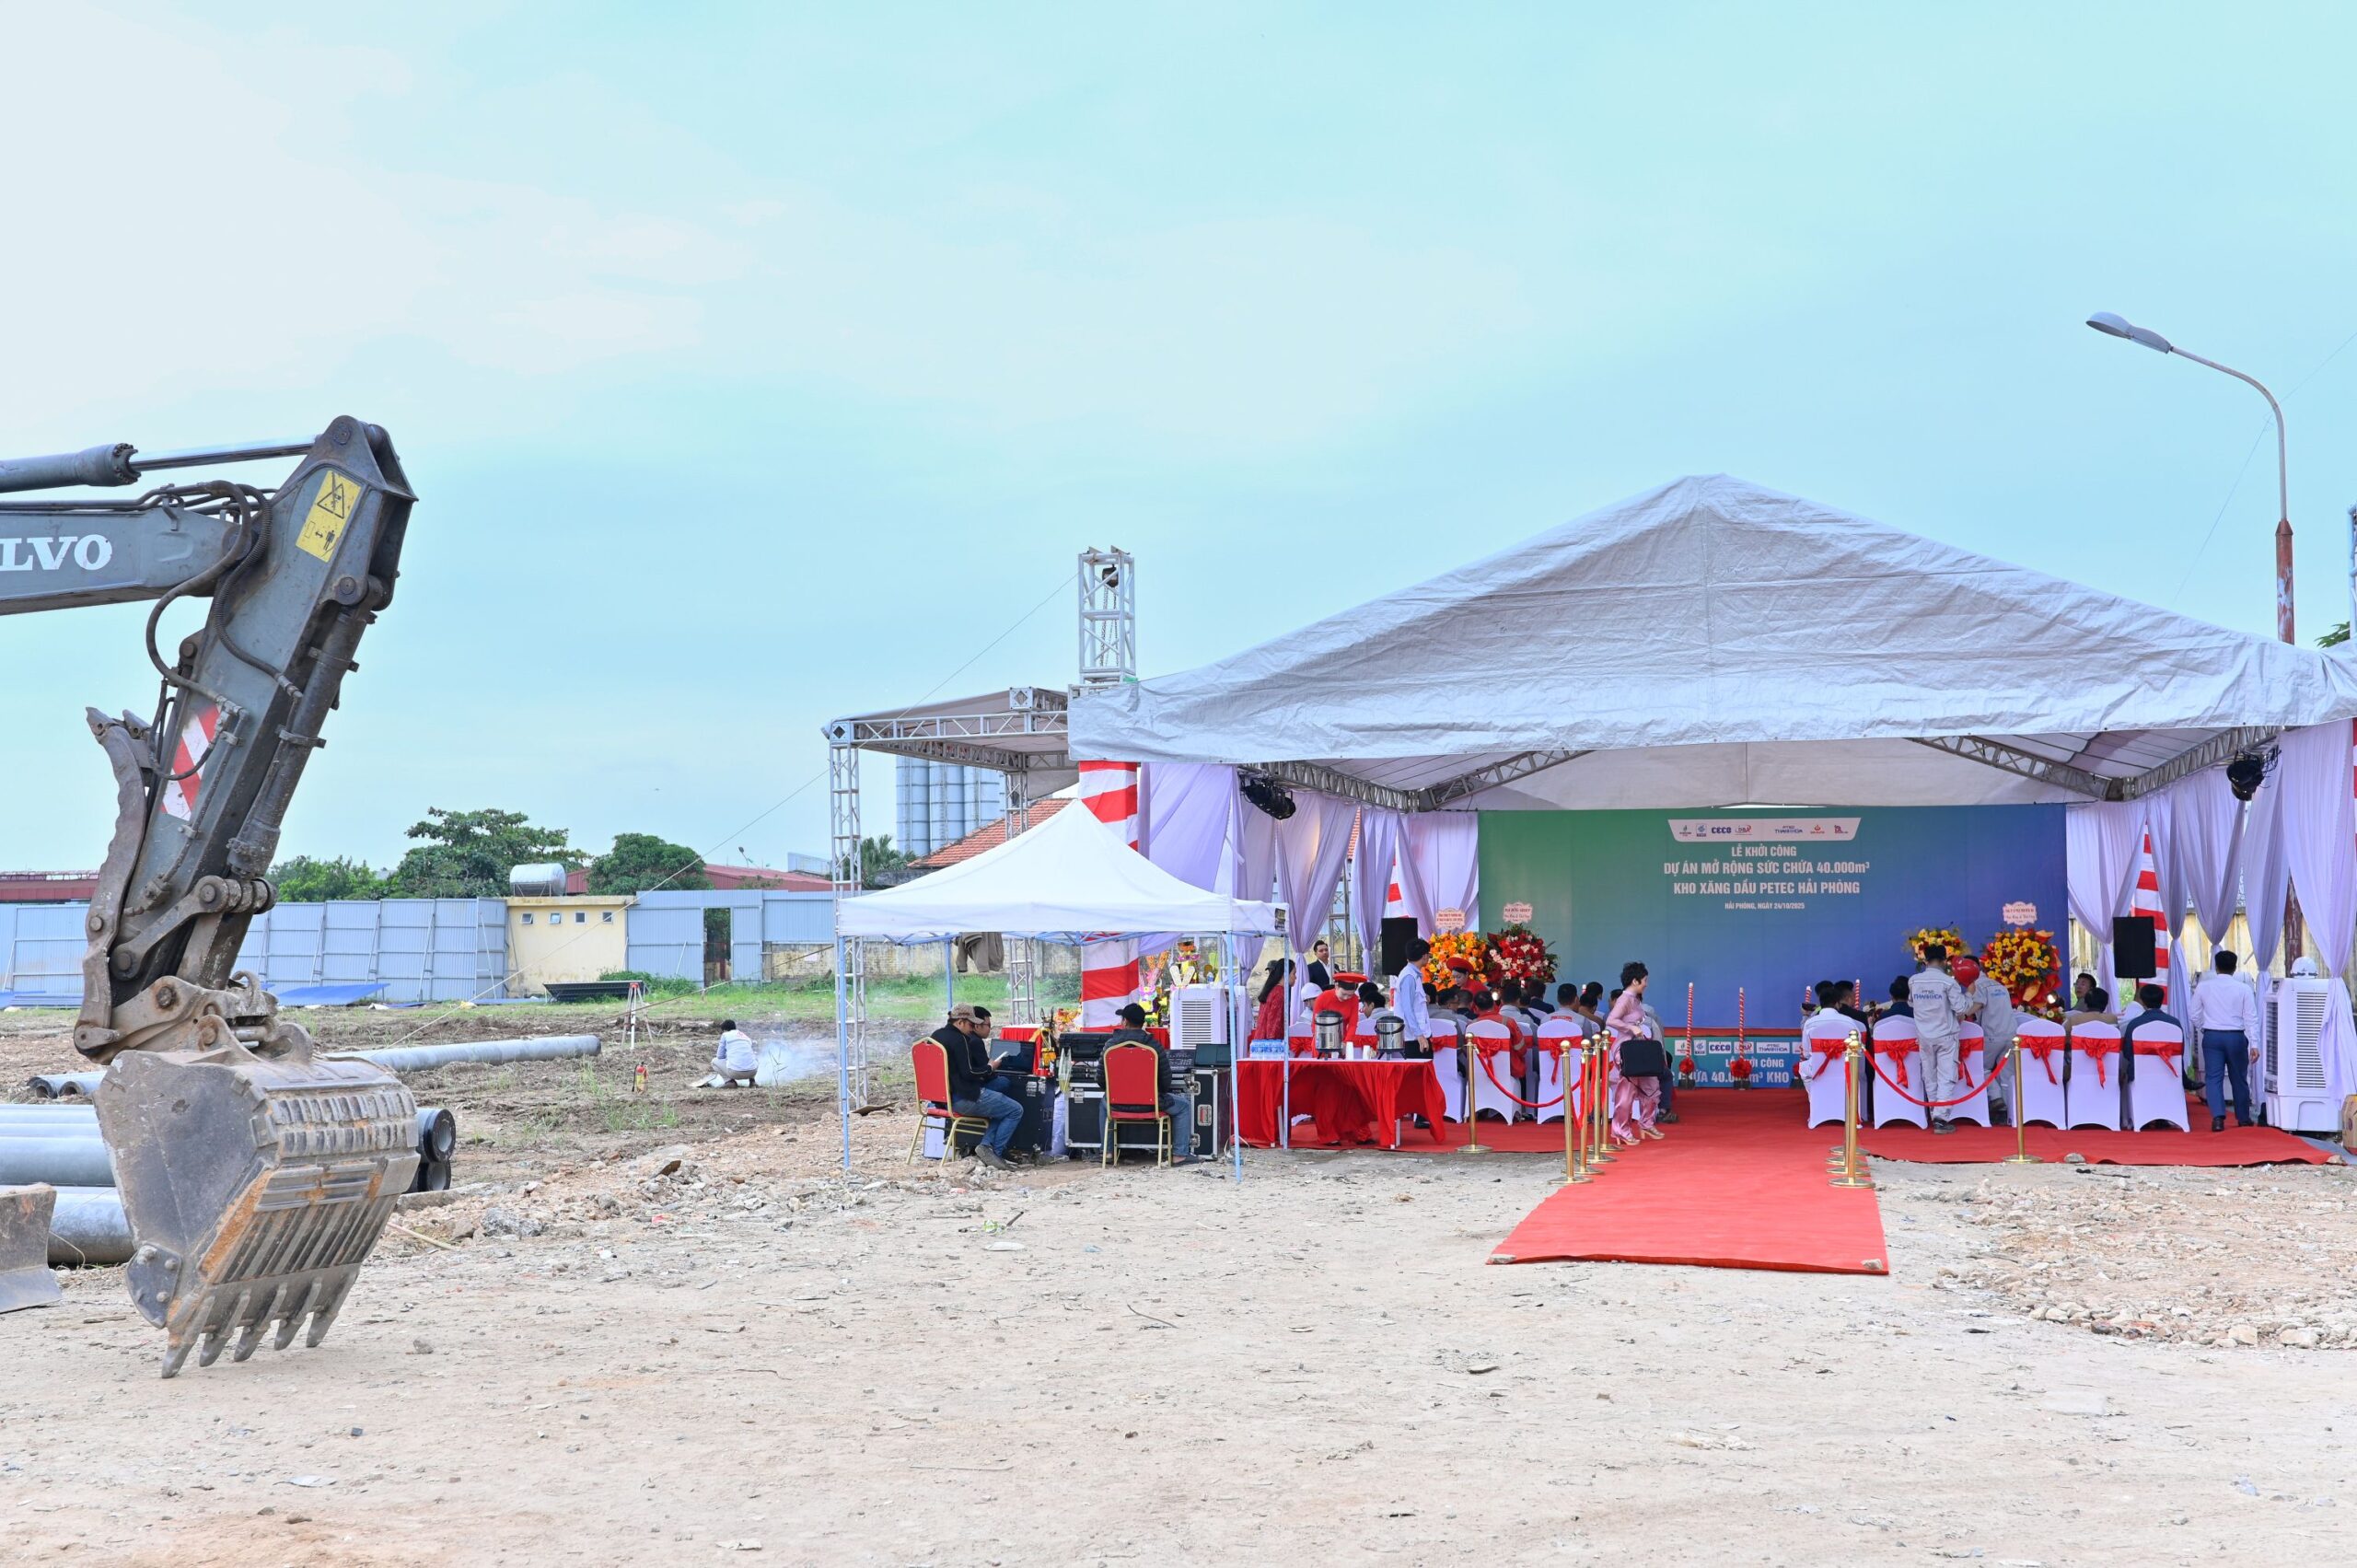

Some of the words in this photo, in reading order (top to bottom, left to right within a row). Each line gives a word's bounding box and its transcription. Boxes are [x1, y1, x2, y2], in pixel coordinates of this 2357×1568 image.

[0, 534, 112, 571] LVO
[1732, 843, 1743, 857] LỄ
[1745, 843, 1768, 857] KHỞI
[1770, 844, 1797, 857] CÔNG
[1664, 861, 1680, 877] DỰ
[1682, 860, 1699, 874] ÁN
[1701, 858, 1720, 874] MỞ
[1723, 860, 1754, 877] RỘNG
[1757, 860, 1780, 874] SỨC
[1782, 859, 1814, 874] CHỨA
[1674, 882, 1696, 894] KHO
[1700, 880, 1731, 894] XĂNG
[1759, 882, 1794, 894] PETEC
[1798, 877, 1817, 894] HẢI
[1820, 879, 1860, 894] PHÒNG
[1760, 1057, 1784, 1068] CÔNG
[1766, 1071, 1790, 1084] KHO
